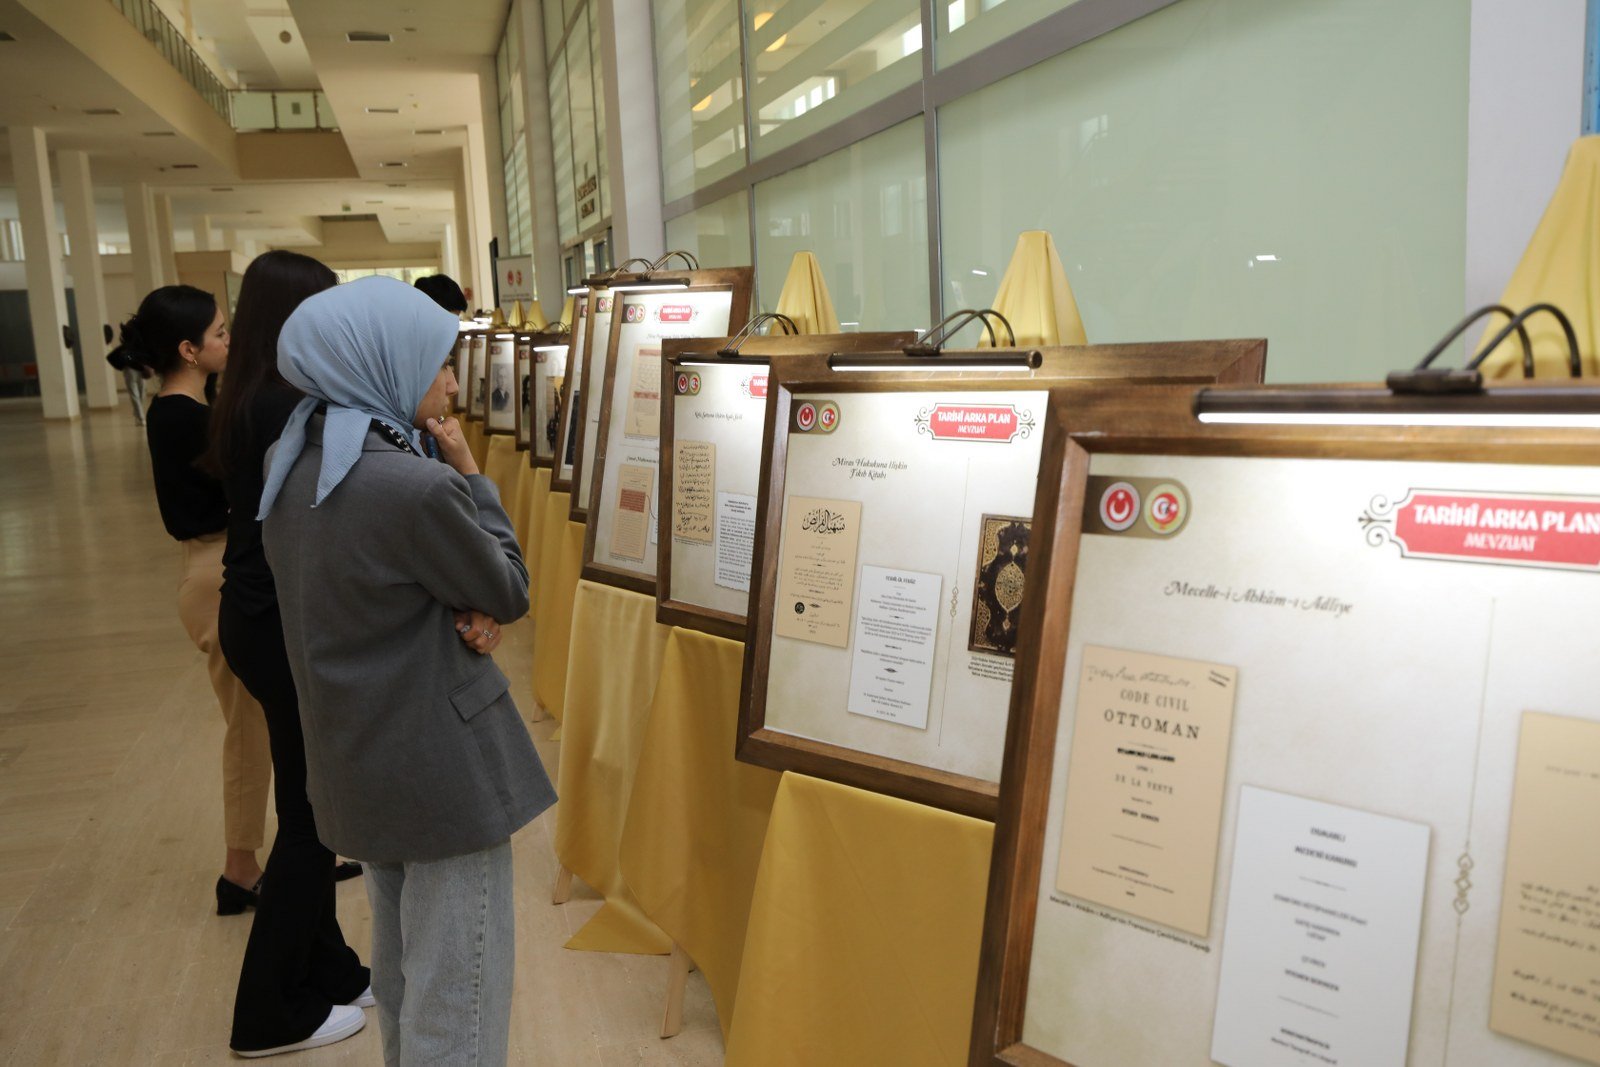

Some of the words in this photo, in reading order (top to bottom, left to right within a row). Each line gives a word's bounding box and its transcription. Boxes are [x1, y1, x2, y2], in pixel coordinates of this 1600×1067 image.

[957, 425, 987, 434] MEVZUAT
[964, 412, 987, 424] ARKA
[988, 413, 1011, 425] PLAN
[1479, 508, 1540, 531] ARKA
[1541, 510, 1600, 534] PLAN
[1463, 532, 1538, 552] MEVZUAT
[1120, 688, 1150, 704] CODE
[1156, 694, 1190, 712] CIVIL
[1104, 708, 1200, 739] OTTOMAN
